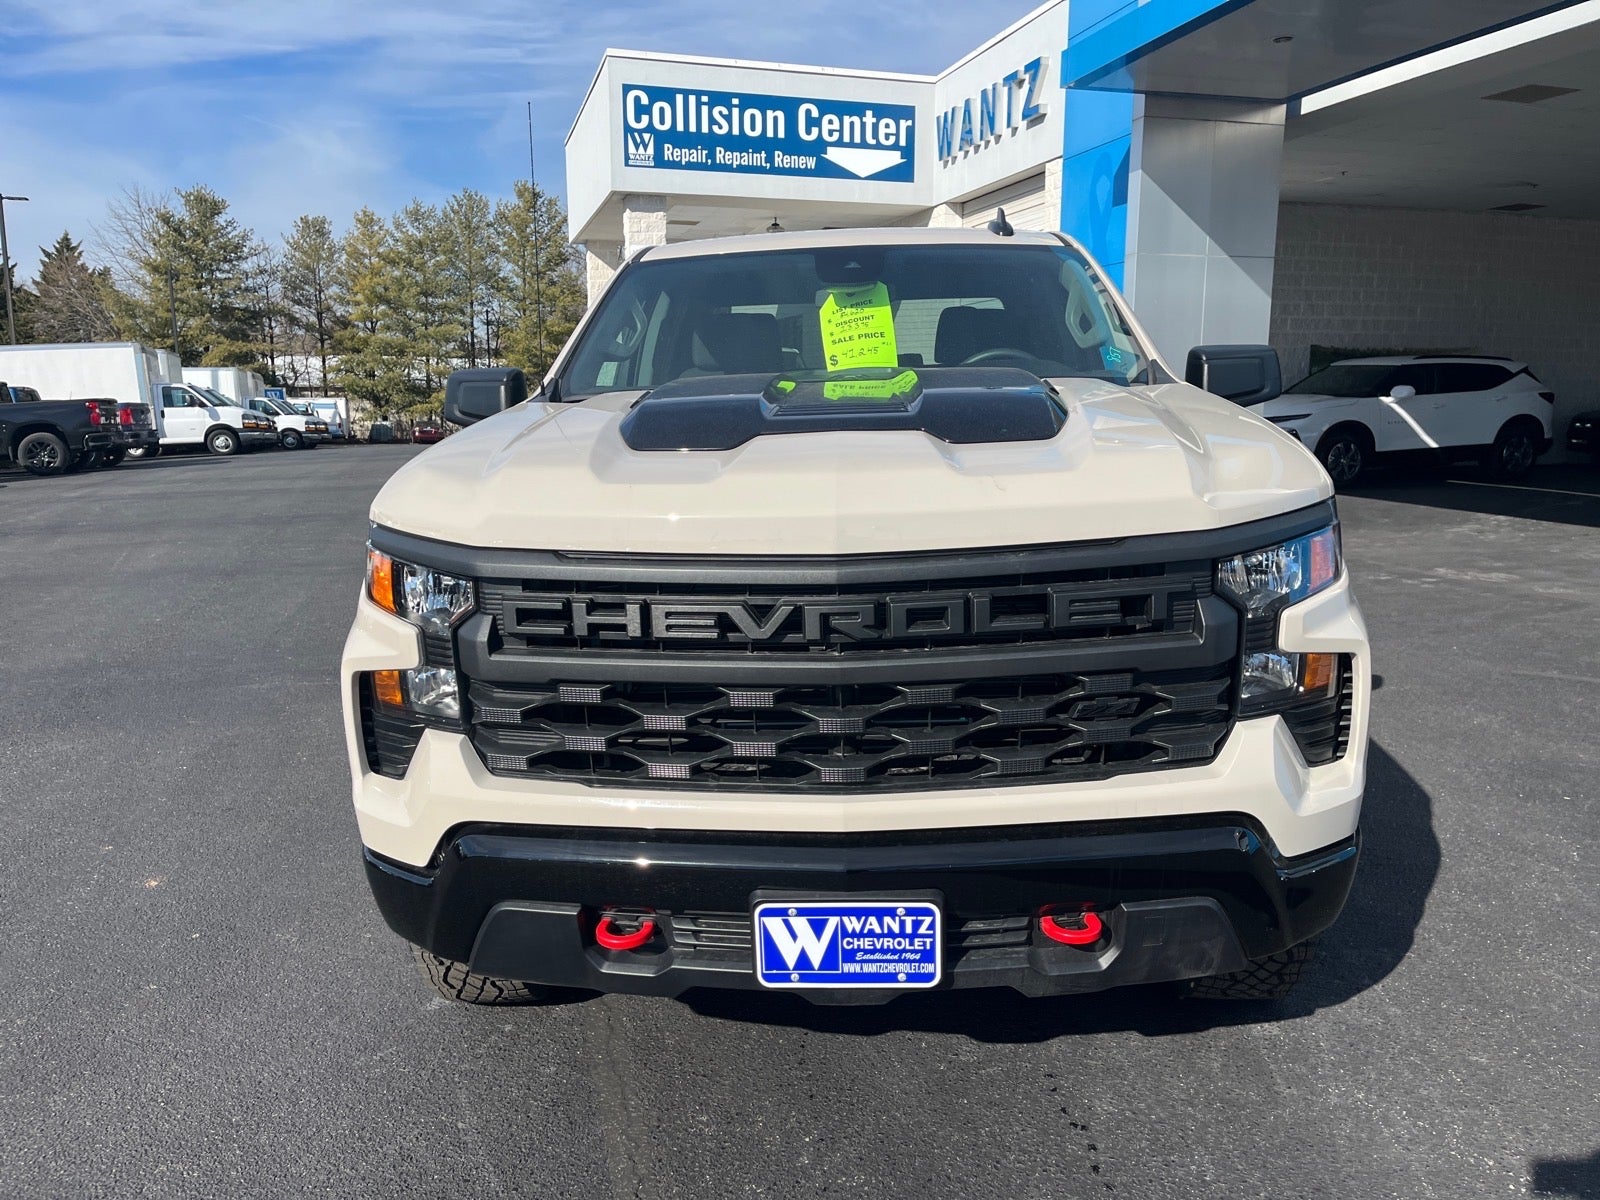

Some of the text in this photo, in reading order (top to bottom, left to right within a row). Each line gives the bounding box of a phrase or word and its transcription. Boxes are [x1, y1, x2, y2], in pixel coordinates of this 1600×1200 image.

[936, 56, 1049, 162] WANTZ
[626, 89, 913, 147] Collision Center
[629, 153, 654, 161] WANTZ
[664, 143, 817, 170] Repair, Repaint, Renew
[832, 299, 874, 315] LIST PRICE
[835, 314, 876, 328] DISCOUNT
[831, 331, 886, 345] SALE PRICE
[829, 354, 839, 367] $
[502, 583, 1194, 642] CHEVROLET
[841, 916, 934, 934] WANTZ
[762, 917, 840, 971] W
[842, 938, 933, 950] CHEVROLET
[855, 951, 922, 960] Established 1964
[842, 962, 935, 974] WWW.WANTZCHEVROLET.COM
